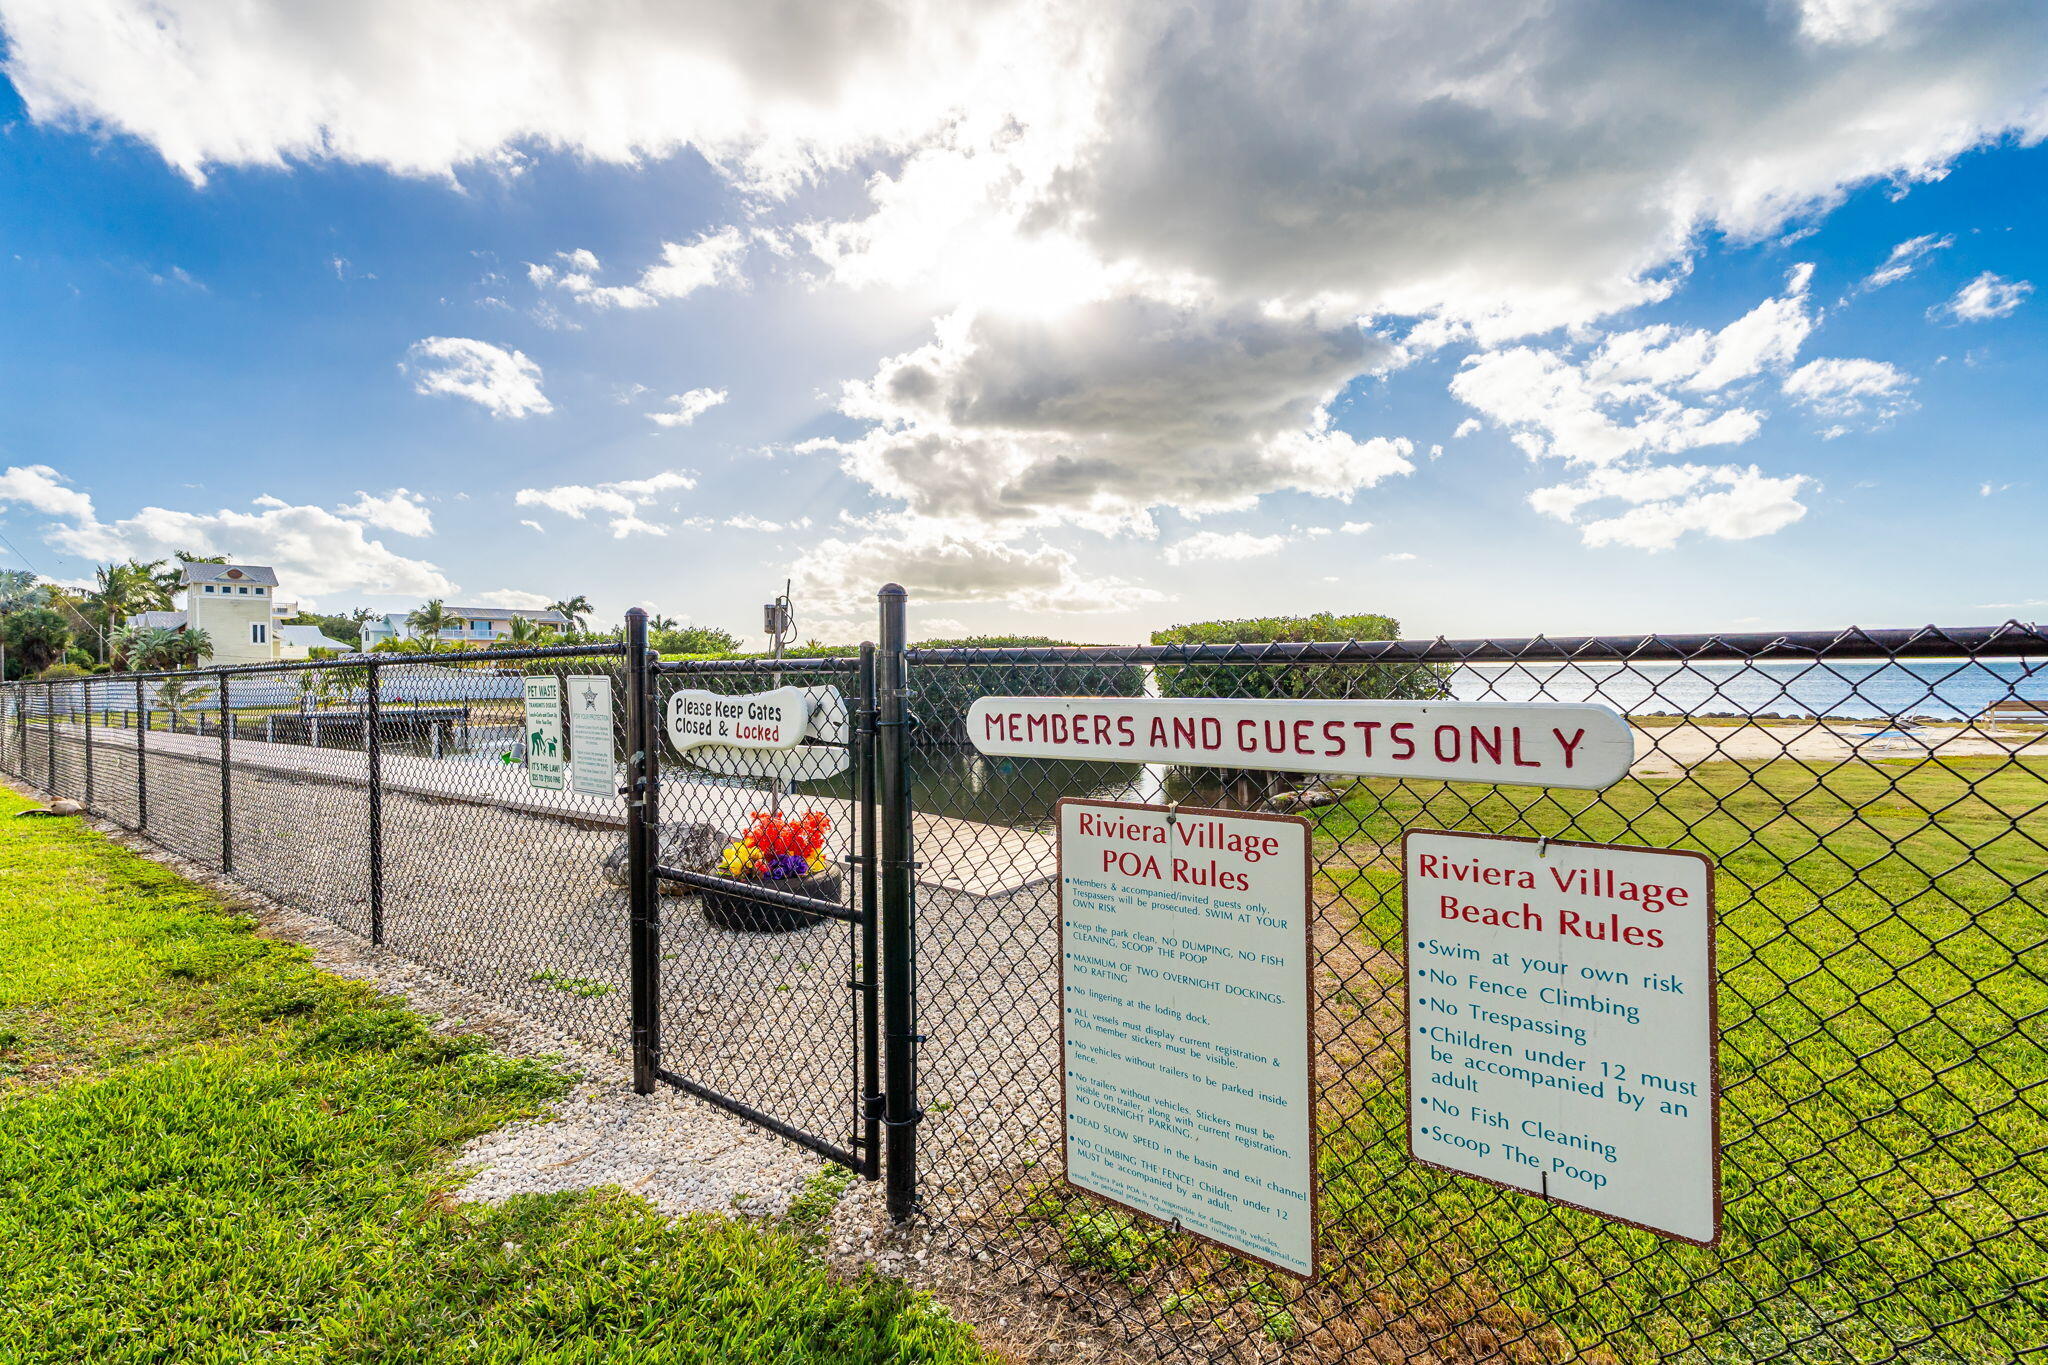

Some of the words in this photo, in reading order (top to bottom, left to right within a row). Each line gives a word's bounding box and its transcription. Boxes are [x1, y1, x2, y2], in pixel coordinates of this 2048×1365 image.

[528, 685, 537, 697] PET
[538, 685, 557, 697] WASTE
[676, 698, 712, 716] Please
[715, 701, 744, 719] Keep
[748, 702, 782, 722] Gates
[675, 717, 712, 736] Closed
[718, 720, 729, 737] &
[735, 722, 779, 742] Locked
[985, 713, 1135, 747] MEMBERS
[1150, 716, 1221, 750] AND
[1237, 719, 1416, 760] GUESTS
[1434, 724, 1585, 769] ONLY
[540, 763, 548, 771] THE
[1079, 812, 1167, 844] Riviera
[1175, 821, 1279, 863] Village
[1103, 849, 1162, 880] POA
[1172, 858, 1249, 892] Rules
[1419, 853, 1537, 890] Riviera
[1549, 866, 1689, 913] Village
[1072, 877, 1107, 890] Members
[1110, 882, 1117, 892] &
[1121, 885, 1209, 905] accompanied/invited
[1213, 899, 1242, 910] guests
[1245, 902, 1270, 916] only.
[1072, 898, 1095, 910] OWN
[1098, 902, 1117, 914] RISK
[1072, 887, 1115, 902] Trespassers
[1118, 895, 1133, 905] will
[1136, 896, 1148, 908] be
[1205, 907, 1233, 921] SWIM
[1237, 913, 1252, 923] AT
[1256, 915, 1288, 930] YOUR
[1440, 895, 1543, 932] Beach
[1559, 909, 1664, 949] Rules
[1072, 920, 1092, 933] Keep
[1095, 923, 1108, 934] the
[1110, 928, 1129, 938] park
[1161, 936, 1178, 947] NO
[1181, 939, 1234, 959] DUMPING,
[1238, 950, 1256, 962] NO
[1260, 954, 1284, 967] FISH
[1121, 940, 1154, 954] SCOOP
[1157, 946, 1175, 959] THE
[1179, 951, 1208, 964] POOP
[1428, 939, 1480, 961] Swim
[1491, 952, 1510, 967] at
[1520, 957, 1569, 976] your
[1580, 967, 1629, 986] own
[1643, 972, 1684, 995] risk
[1073, 952, 1116, 969] MAXIMUM
[1119, 962, 1132, 972] OF
[1135, 965, 1159, 979] TWO
[1162, 971, 1221, 991] OVERNIGHT
[1073, 963, 1088, 974] NO
[1090, 967, 1128, 983] RAFTING
[1429, 968, 1458, 987] No
[1468, 974, 1528, 999] Fence
[1539, 987, 1640, 1025] Climbing
[1073, 985, 1086, 996] No
[1088, 988, 1123, 1007] lingering
[1126, 999, 1134, 1008] at
[1137, 1000, 1151, 1011] the
[1154, 1003, 1182, 1022] loding
[1185, 1011, 1210, 1026] dock.
[1430, 996, 1458, 1016] No
[1467, 1003, 1587, 1047] Trespassing
[1074, 1007, 1089, 1019] ALL
[1092, 1013, 1119, 1026] vessels
[1122, 1021, 1142, 1032] must
[1145, 1024, 1175, 1042] display
[1179, 1036, 1211, 1050] current
[1215, 1044, 1267, 1064] registration
[1272, 1057, 1281, 1068] &
[1074, 1017, 1092, 1030] POA
[1095, 1025, 1127, 1039] member
[1131, 1034, 1162, 1049] stickers
[1165, 1043, 1186, 1055] must
[1189, 1047, 1202, 1059] be
[1205, 1053, 1238, 1069] visible.
[1430, 1026, 1513, 1057] Children
[1524, 1048, 1586, 1072] under
[1600, 1061, 1626, 1082] 12
[1640, 1073, 1698, 1098] must
[1074, 1039, 1087, 1050] No
[1089, 1045, 1122, 1060] vehicles
[1124, 1055, 1155, 1070] without
[1159, 1064, 1189, 1079] trailers
[1192, 1073, 1202, 1083] to
[1205, 1075, 1217, 1087] be
[1221, 1082, 1254, 1098] parked
[1258, 1090, 1288, 1107] inside
[1430, 1044, 1453, 1064] be
[1464, 1057, 1604, 1099] accompanied
[1617, 1085, 1645, 1112] by
[1659, 1101, 1688, 1118] an
[1430, 1070, 1479, 1093] adult
[1075, 1071, 1087, 1083] No
[1090, 1077, 1117, 1092] trailers
[1119, 1087, 1151, 1103] without
[1195, 1108, 1231, 1128] Stickers
[1235, 1123, 1258, 1136] must
[1262, 1128, 1275, 1141] be
[1075, 1084, 1100, 1098] visible
[1103, 1093, 1114, 1102] on
[1117, 1097, 1143, 1113] trailer,
[1147, 1106, 1171, 1123] along
[1174, 1116, 1194, 1128] with
[1197, 1123, 1230, 1140] current
[1234, 1135, 1291, 1159] registration.
[1076, 1094, 1090, 1105] NO
[1093, 1099, 1145, 1123] OVERNIGHT
[1432, 1096, 1460, 1117] No
[1471, 1106, 1509, 1130] Fish
[1520, 1120, 1618, 1163] Cleaning
[1076, 1115, 1100, 1130] DEAD
[1103, 1124, 1129, 1140] SLOW
[1132, 1134, 1160, 1151] SPEED
[1163, 1144, 1172, 1156] in
[1175, 1149, 1190, 1162] the
[1193, 1154, 1218, 1171] basin
[1222, 1167, 1240, 1179] and
[1244, 1175, 1262, 1187] exit
[1266, 1181, 1307, 1202] channel
[1077, 1136, 1091, 1149] NO
[1094, 1143, 1137, 1166] CLIMBING
[1140, 1159, 1158, 1174] THE
[1162, 1167, 1194, 1187] FENCE!
[1198, 1181, 1238, 1202] Children
[1242, 1198, 1271, 1214] under
[1276, 1208, 1288, 1221] 12
[1077, 1148, 1100, 1162] MUST
[1104, 1156, 1114, 1168] be
[1117, 1163, 1172, 1190] accompanied
[1176, 1183, 1188, 1197] by
[1191, 1192, 1203, 1201] an
[1207, 1197, 1233, 1213] adult.
[1432, 1125, 1491, 1158] Scoop
[1501, 1143, 1540, 1168] The
[1552, 1157, 1607, 1191] Poop
